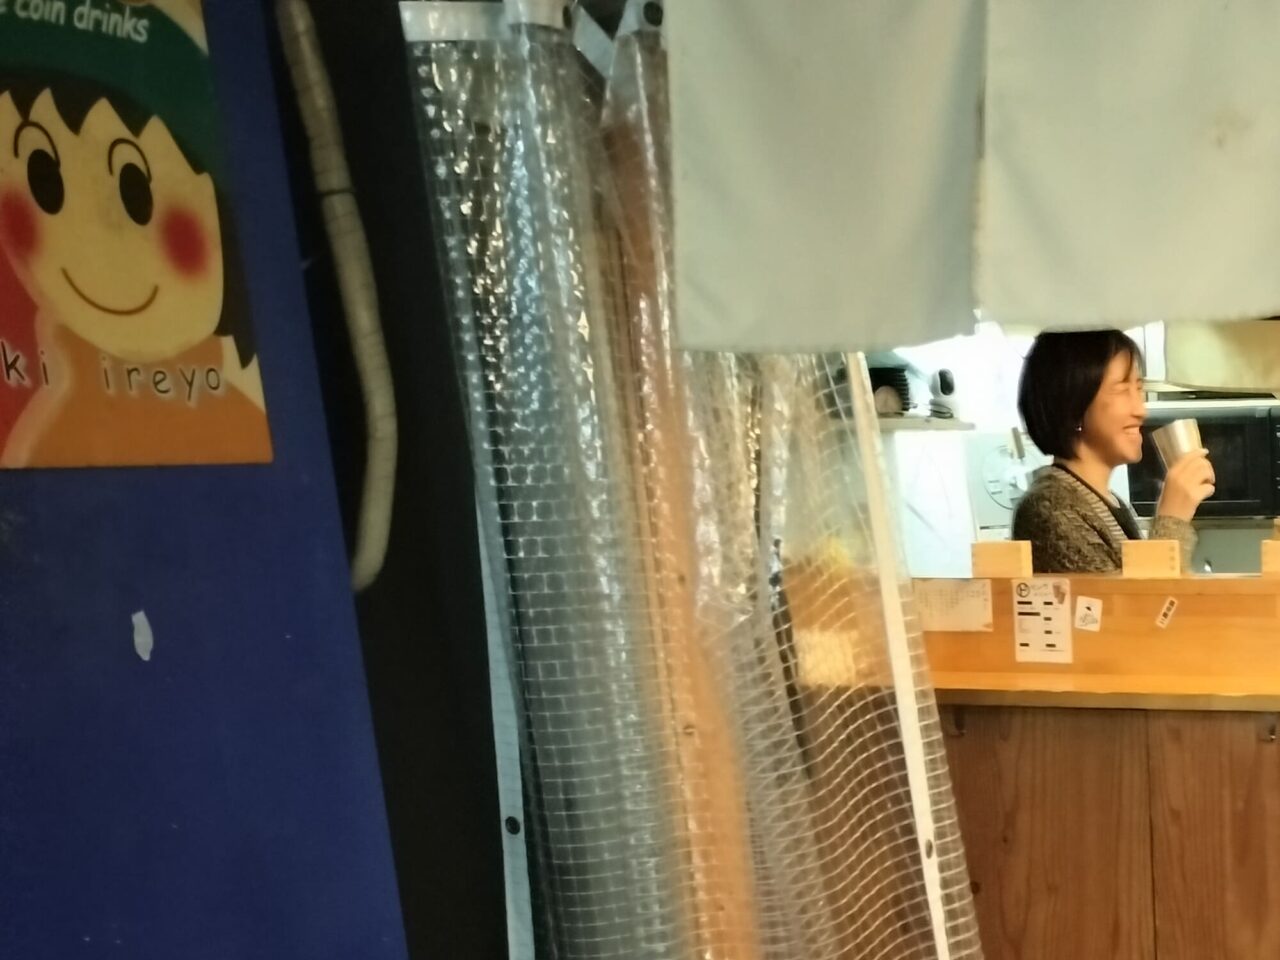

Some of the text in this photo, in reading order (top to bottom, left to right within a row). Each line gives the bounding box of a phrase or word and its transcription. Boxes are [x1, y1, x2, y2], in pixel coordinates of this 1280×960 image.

[15, 0, 150, 43] coin drinks
[0, 340, 221, 402] ki ireyo
